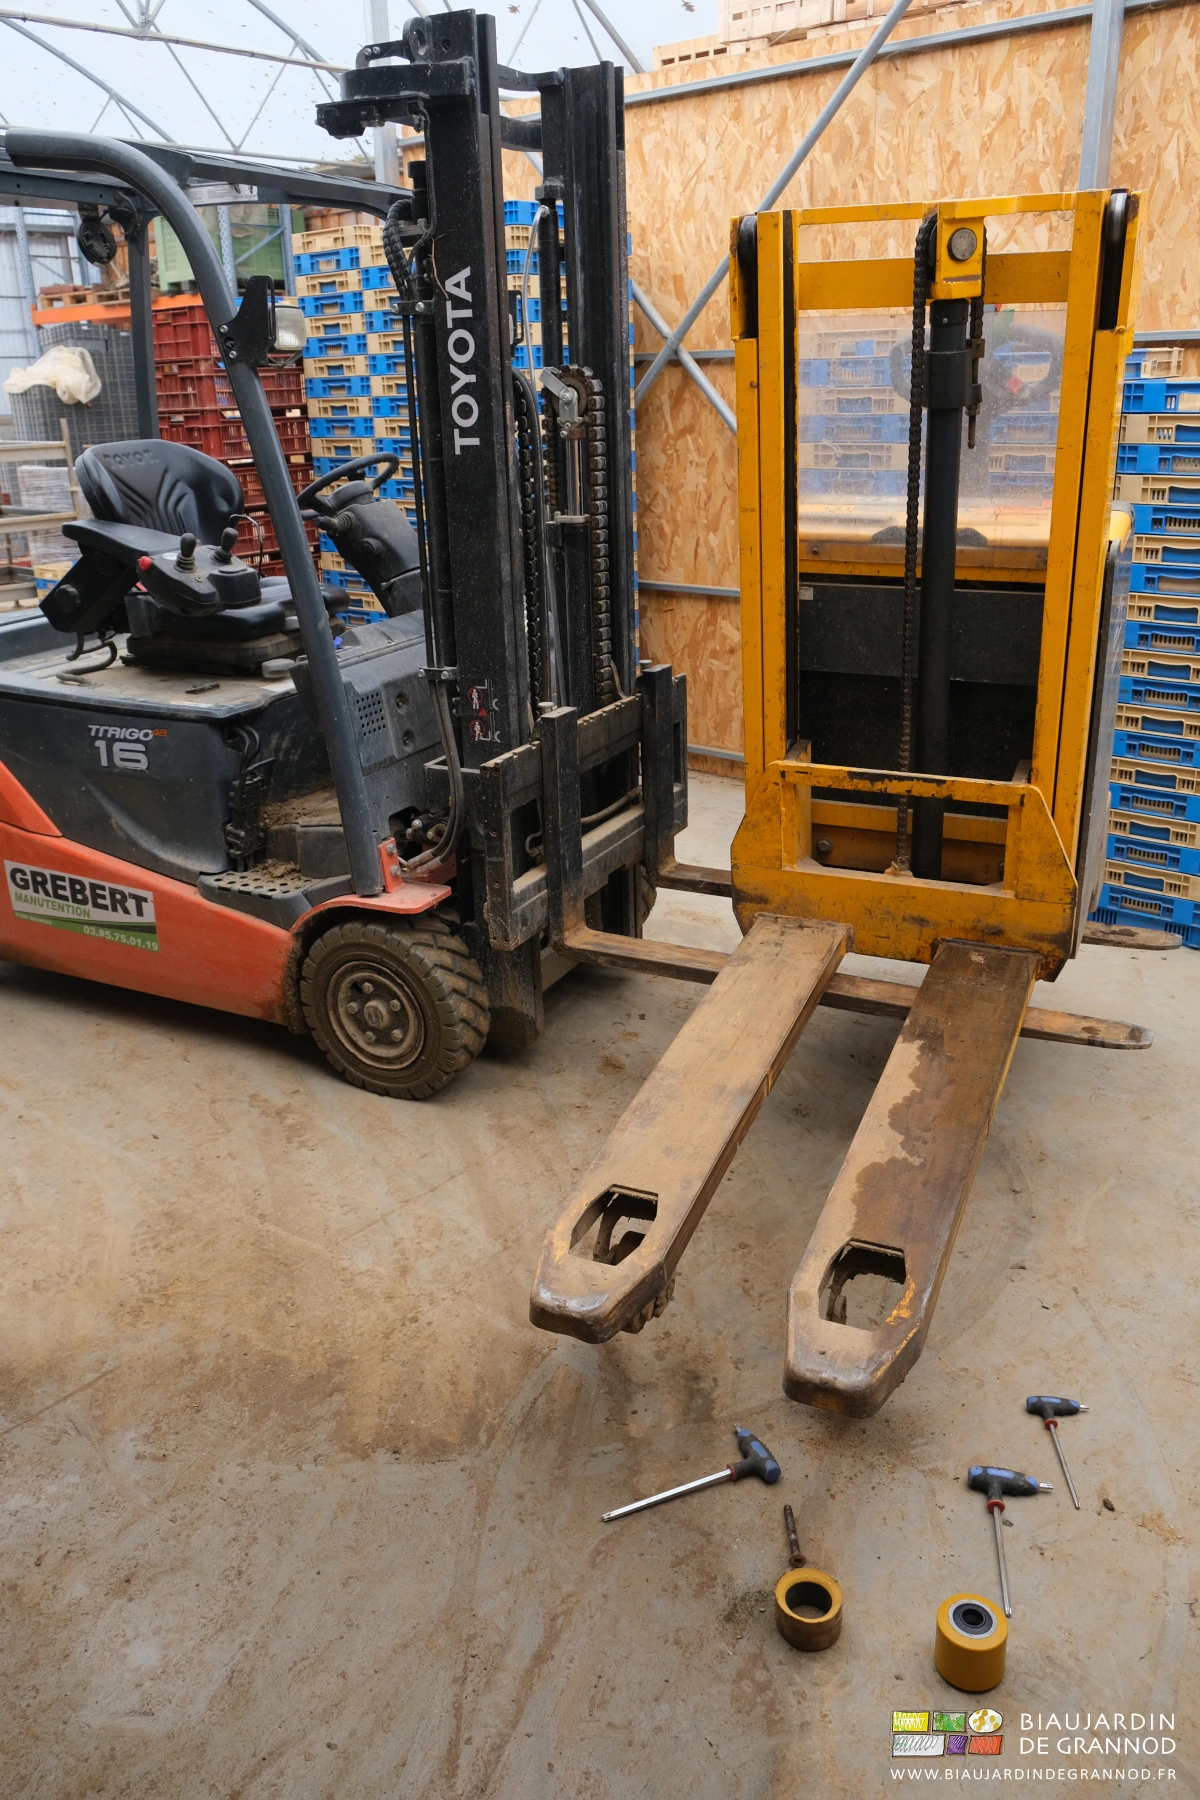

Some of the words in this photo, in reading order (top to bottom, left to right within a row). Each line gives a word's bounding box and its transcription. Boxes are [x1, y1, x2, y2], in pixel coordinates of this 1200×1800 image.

[444, 265, 481, 456] TOYOTA
[94, 739, 149, 770] 16
[10, 867, 148, 917] GREBERT
[14, 891, 91, 918] MANUTENTION
[83, 925, 158, 951] 03.85.75.01.19
